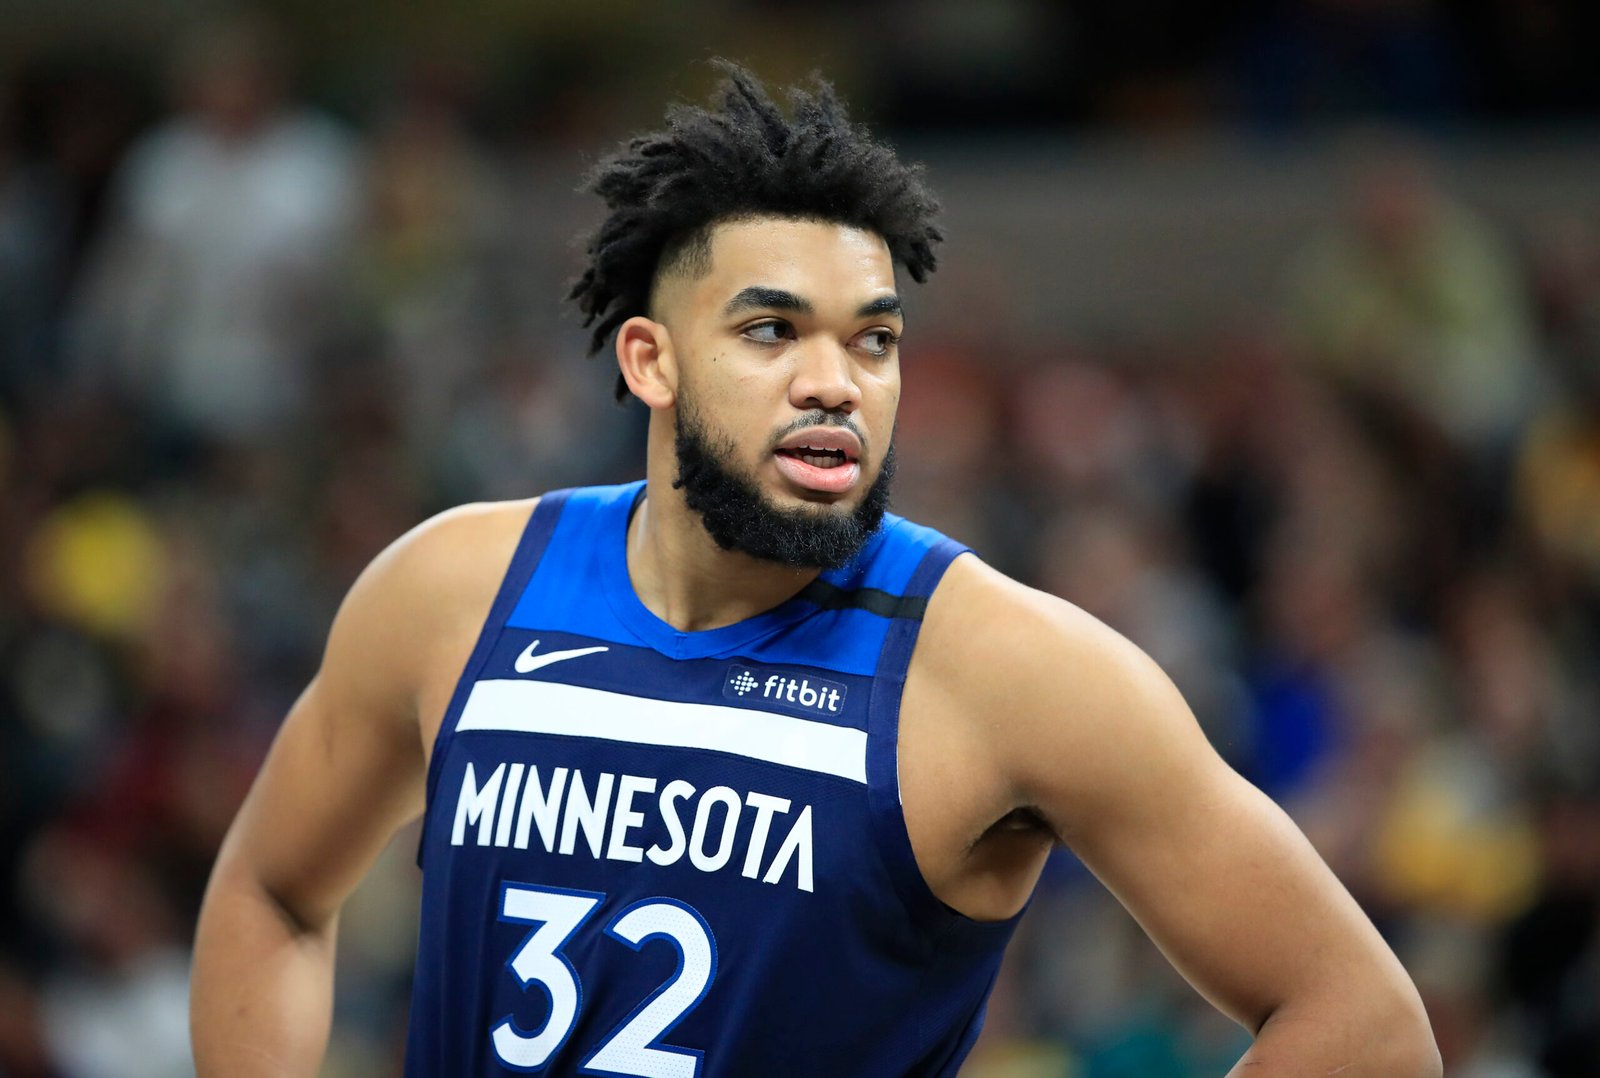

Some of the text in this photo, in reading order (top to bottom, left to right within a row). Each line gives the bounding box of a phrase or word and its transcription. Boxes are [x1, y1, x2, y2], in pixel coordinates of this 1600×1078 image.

[763, 675, 840, 711] fitbit
[451, 762, 814, 893] MINNESOTA
[490, 882, 717, 1078] 32
